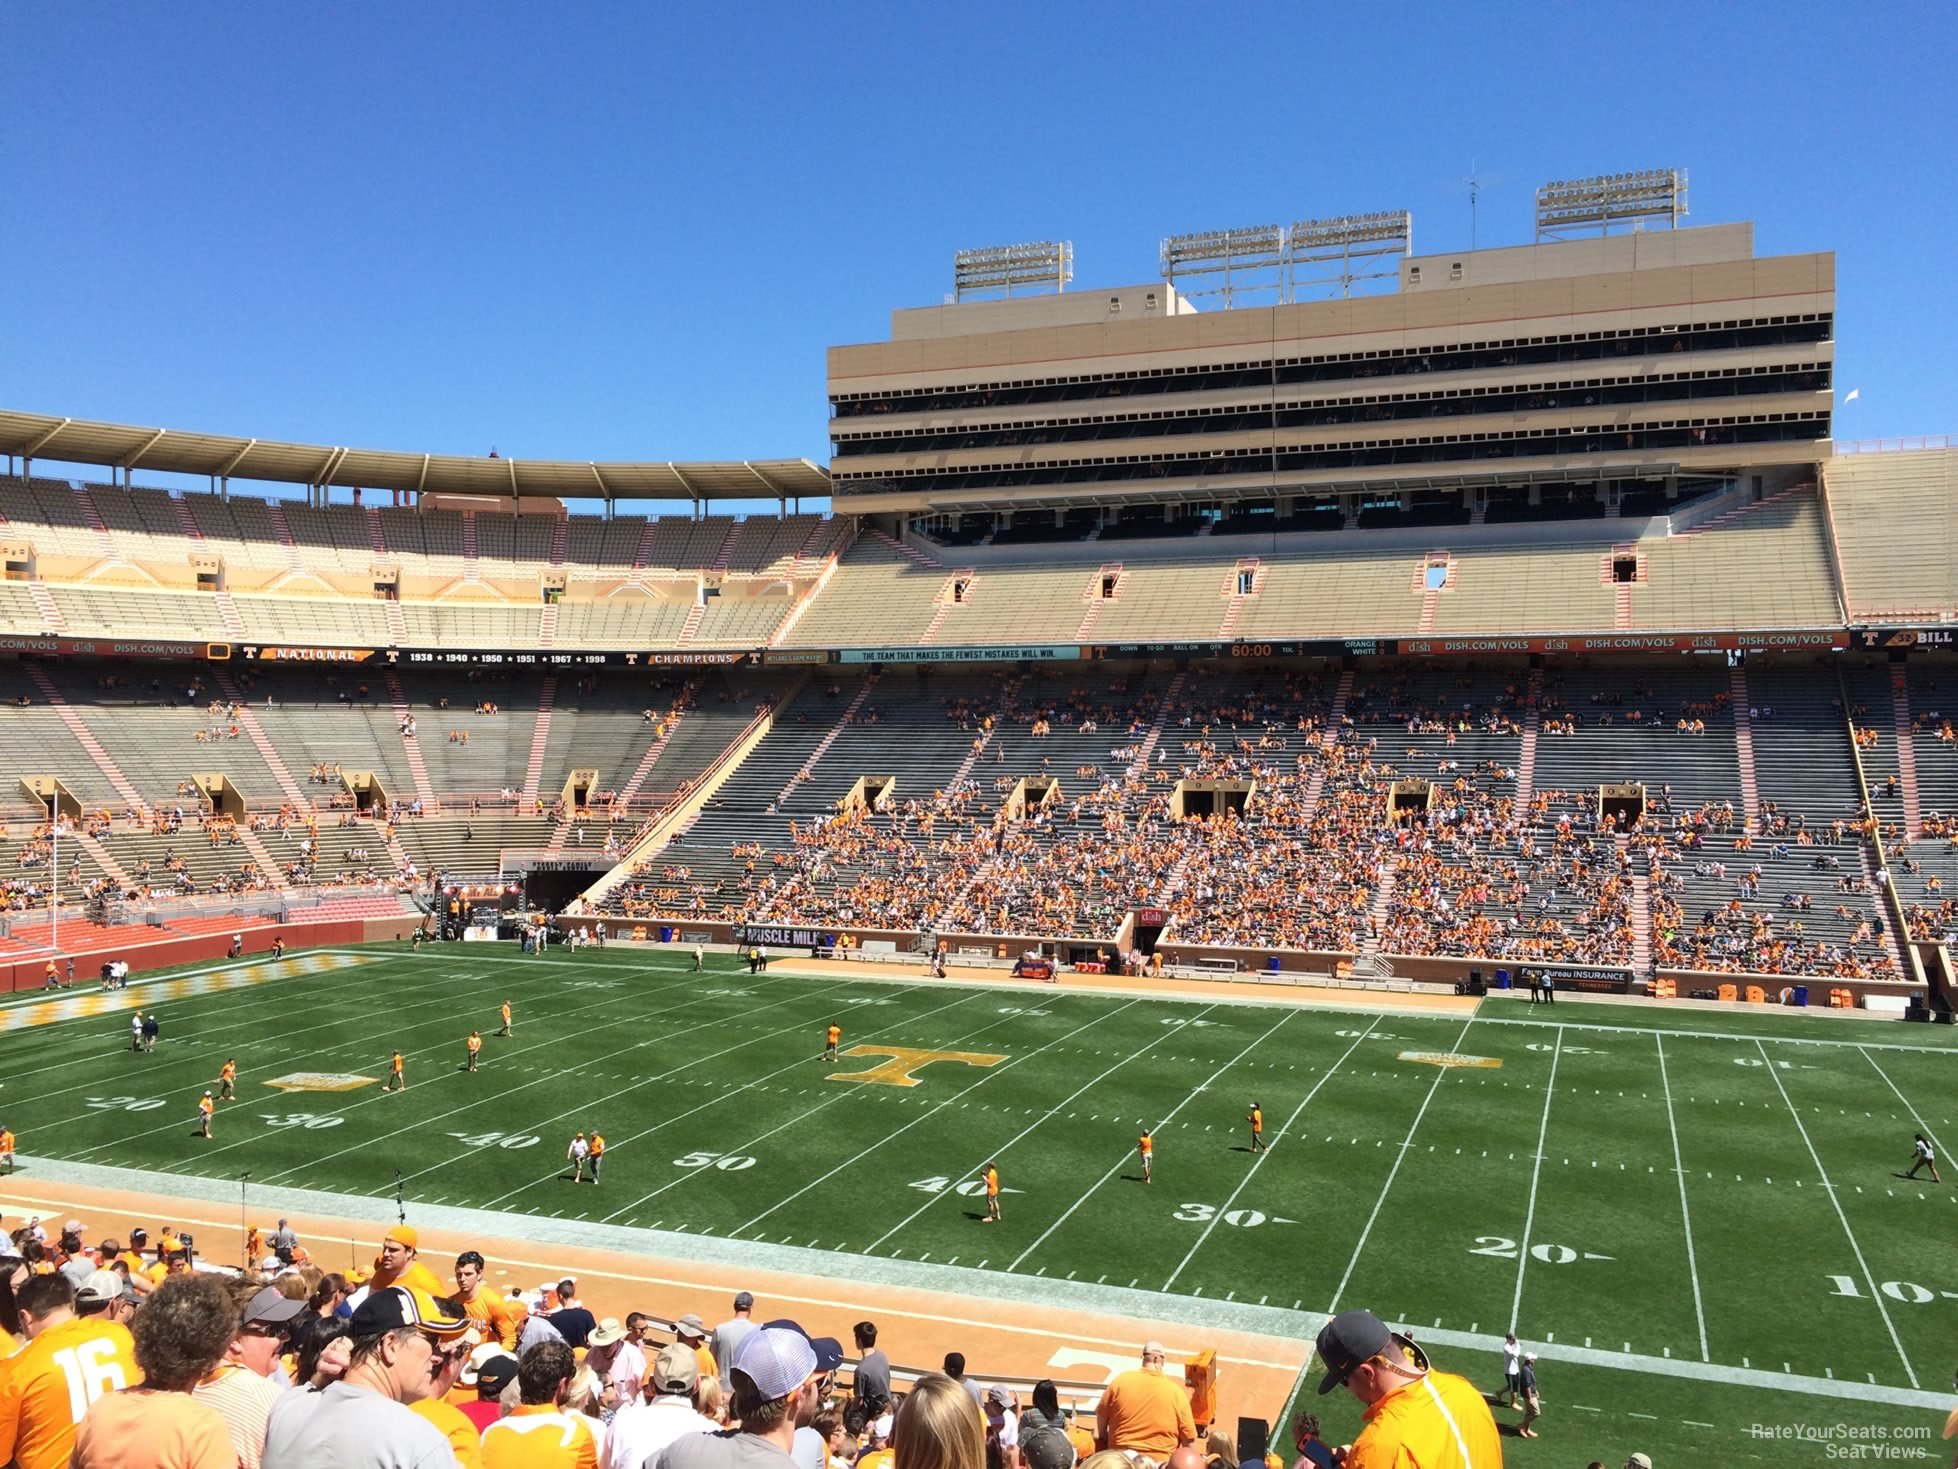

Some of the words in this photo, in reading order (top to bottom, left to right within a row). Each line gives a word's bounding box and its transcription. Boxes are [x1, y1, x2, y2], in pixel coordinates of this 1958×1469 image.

[1586, 638, 1674, 649] DISH.COM/VOLS
[1738, 635, 1833, 646] DISH.COM/VOLS
[1897, 634, 1911, 642] 32
[1917, 632, 1952, 643] BILL
[114, 645, 194, 655] DISH.COM/VOLS
[1232, 644, 1271, 657] 60:00
[1445, 640, 1529, 651] DISH.COM/VOLS
[277, 650, 356, 660] NATIONAL
[410, 653, 433, 662] 1938
[446, 654, 468, 662] 1940
[482, 655, 502, 663] 1950
[517, 655, 535, 663] 1951
[551, 655, 572, 663] 1967
[585, 655, 605, 663] 1998
[655, 655, 733, 664] CHAMPIONS
[877, 652, 895, 660] TEAM
[897, 652, 914, 660] THAT
[941, 651, 953, 659] THE
[956, 651, 982, 659] FEWEST
[985, 650, 1019, 658] MISTAKES
[1022, 650, 1038, 658] WILL
[1142, 912, 1161, 921] dish
[747, 929, 790, 943] MUSCLE
[1573, 972, 1625, 980] INSURANCE
[101, 1096, 167, 1112] 20
[280, 1113, 346, 1129] 30
[459, 1131, 541, 1149] 40
[672, 1151, 757, 1172] 50
[907, 1177, 988, 1196] 40
[1172, 1203, 1266, 1228] 30
[1468, 1236, 1577, 1264] 20
[1825, 1274, 1934, 1304] 10
[53, 1337, 127, 1424] 16
